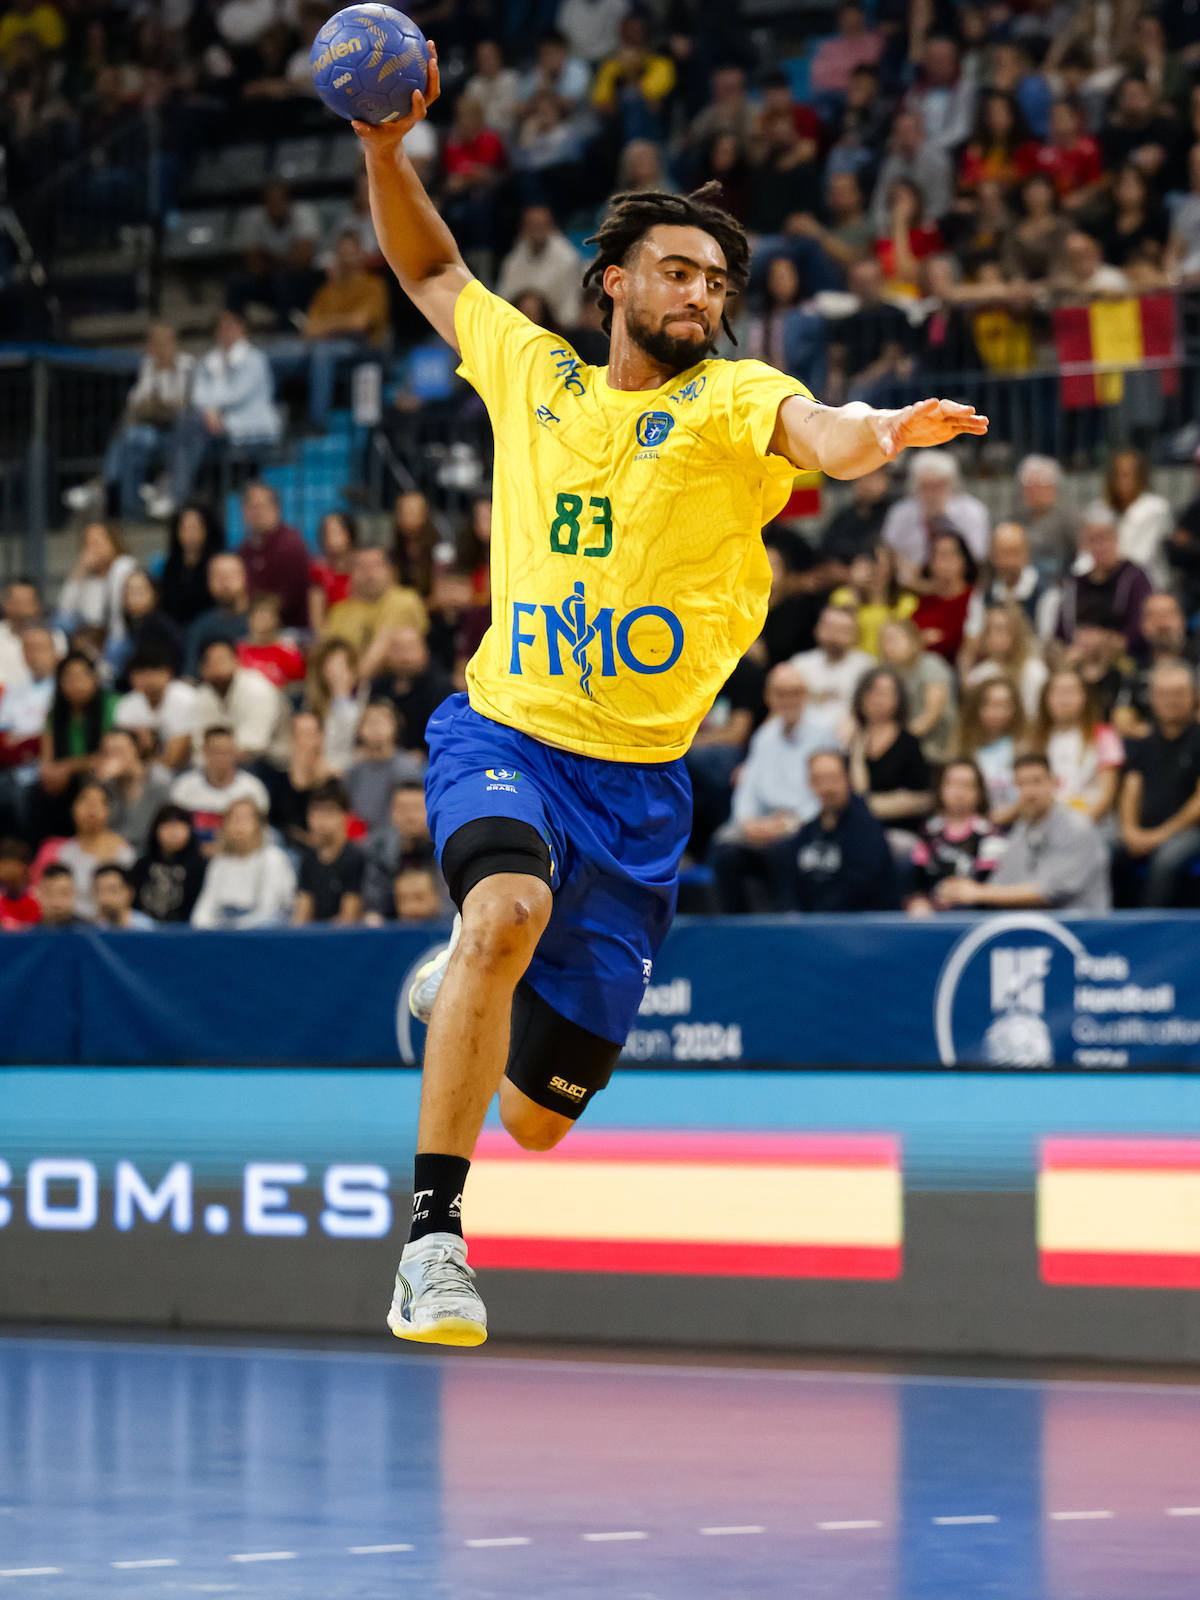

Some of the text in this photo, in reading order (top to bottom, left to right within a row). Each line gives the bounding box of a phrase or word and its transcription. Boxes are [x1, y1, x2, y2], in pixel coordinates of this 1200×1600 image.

[633, 452, 661, 461] BRASIL
[550, 493, 613, 557] 83
[486, 785, 519, 794] BRASIL
[1074, 983, 1176, 1013] Handball
[671, 1021, 743, 1060] 2024
[549, 1075, 588, 1099] SELECT
[0, 1158, 394, 1239] OM.ES
